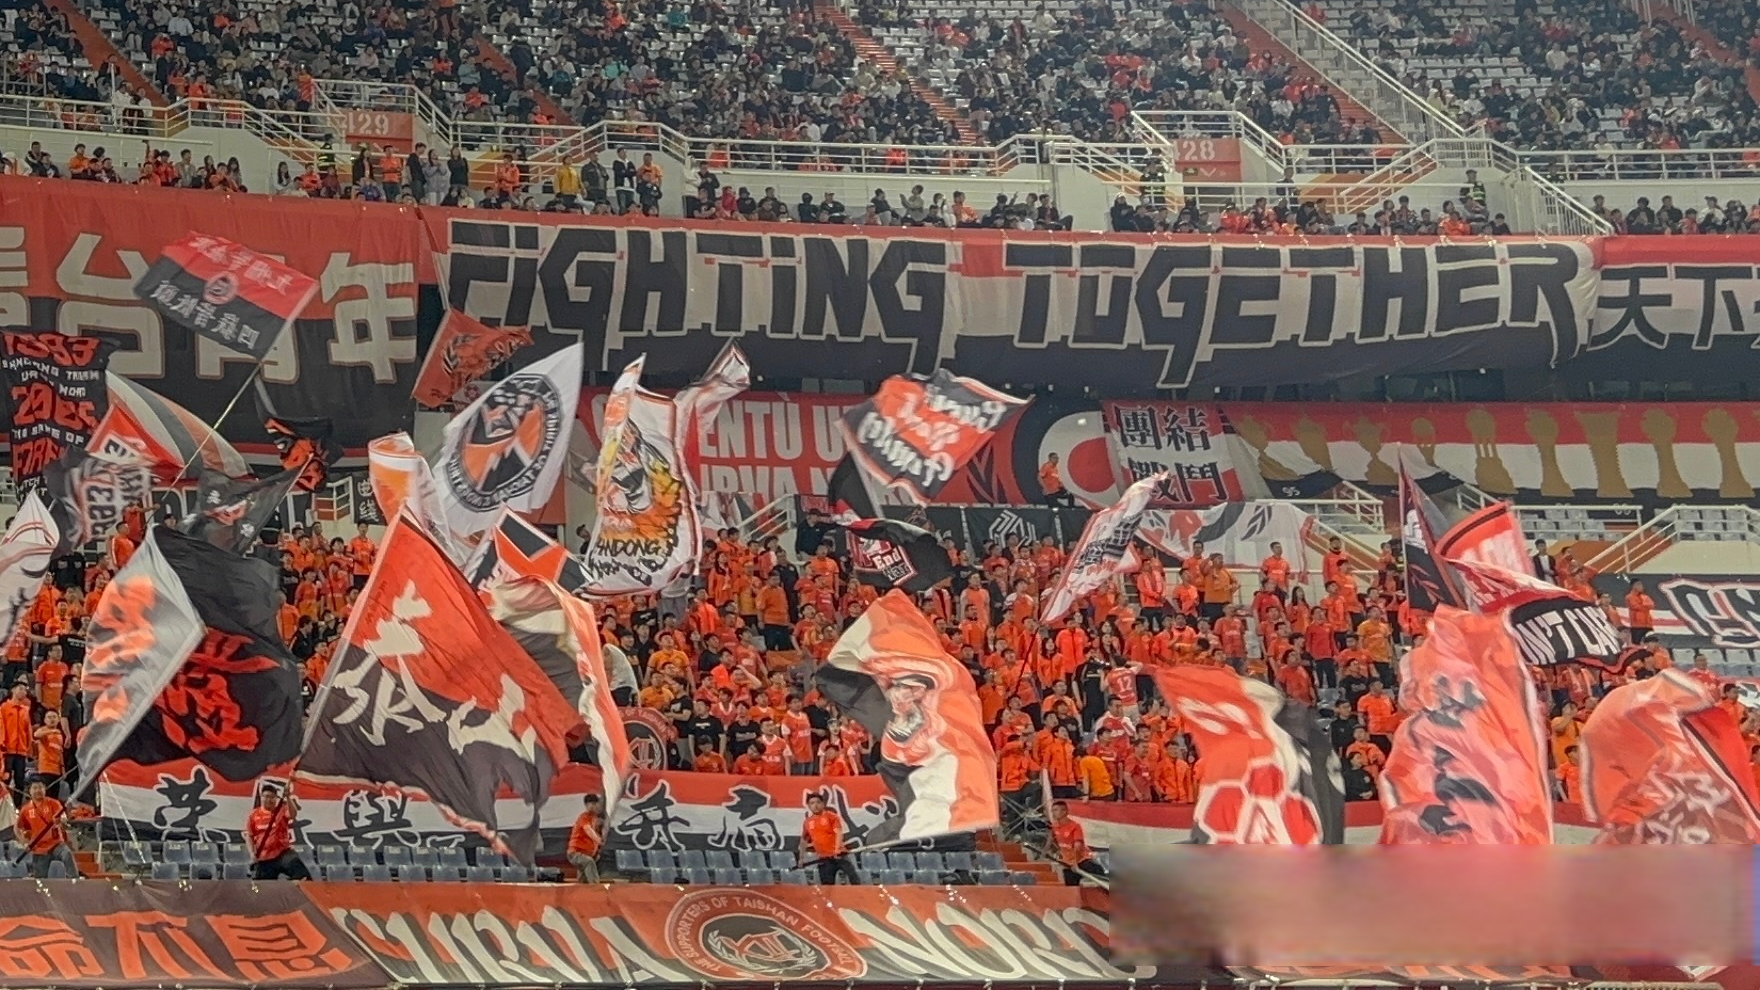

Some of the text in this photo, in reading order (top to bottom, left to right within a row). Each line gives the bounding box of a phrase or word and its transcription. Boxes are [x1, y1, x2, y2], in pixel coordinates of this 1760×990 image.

[1174, 139, 1216, 161] 28
[448, 218, 950, 376] FIGHTING
[1002, 240, 1582, 389] TOGETHER
[1589, 264, 1760, 350] 天下
[675, 899, 711, 964] SUPPORTERS
[712, 895, 728, 909] OF
[735, 897, 799, 927] TAISHAN
